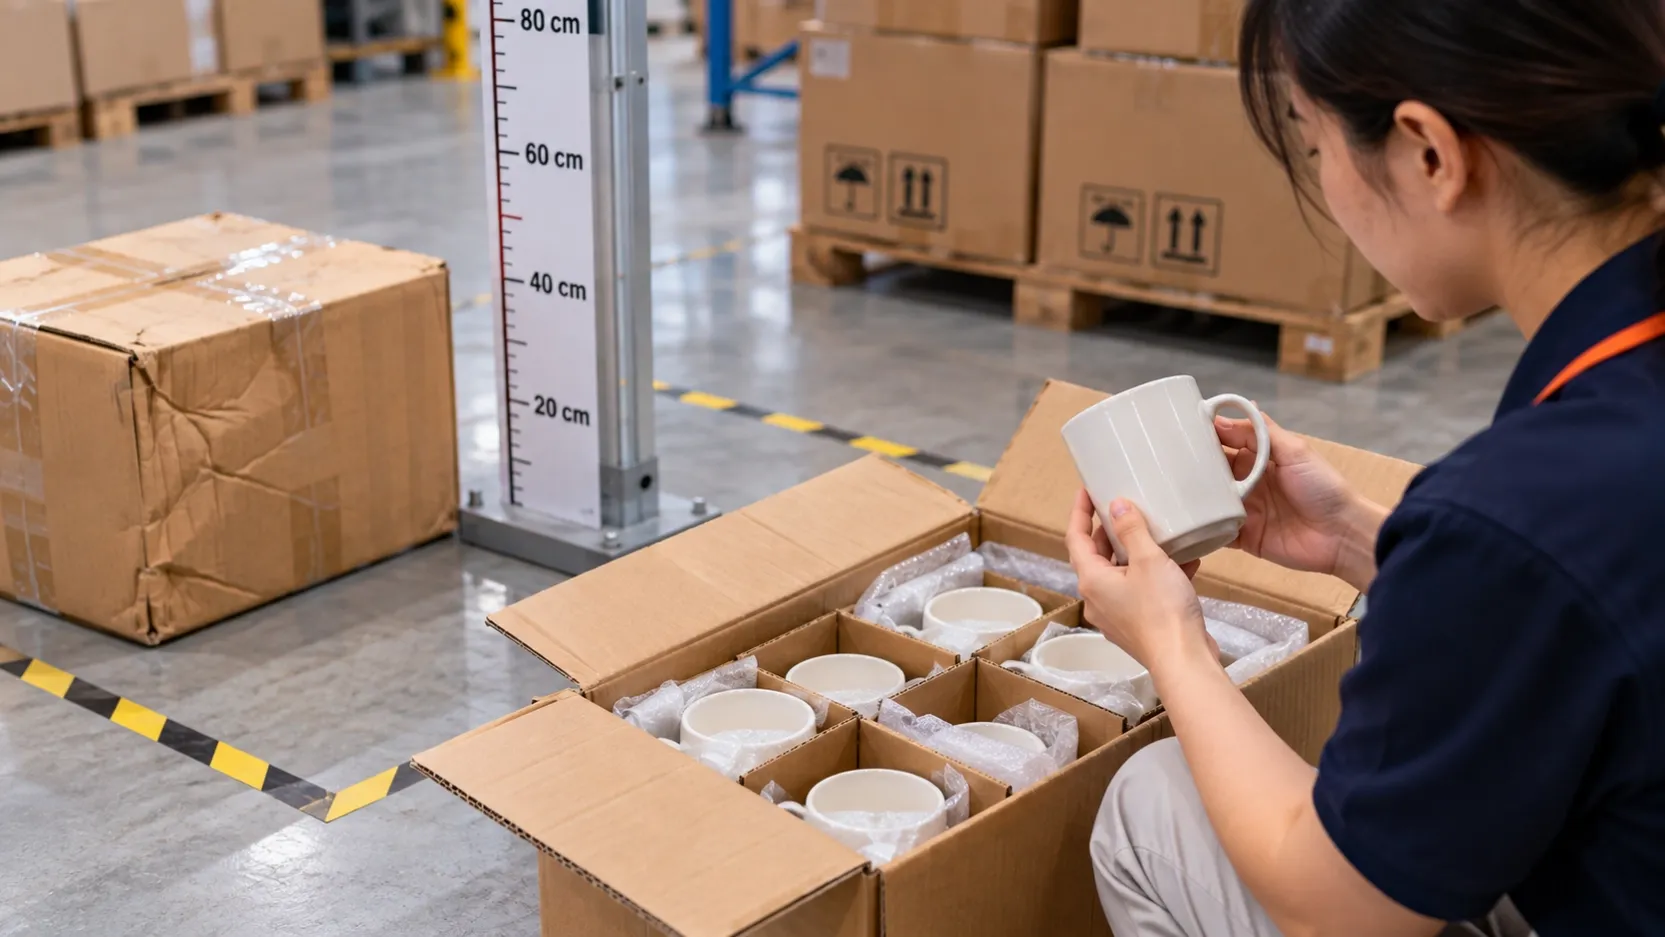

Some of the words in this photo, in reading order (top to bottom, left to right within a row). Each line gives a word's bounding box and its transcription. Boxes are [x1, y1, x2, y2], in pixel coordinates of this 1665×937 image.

[520, 8, 545, 33] 80
[550, 15, 580, 35] cm
[525, 142, 549, 166] 60
[554, 150, 583, 171] cm
[529, 271, 553, 295] 40
[558, 280, 587, 301] cm
[534, 394, 557, 419] 20
[561, 405, 590, 427] cm
